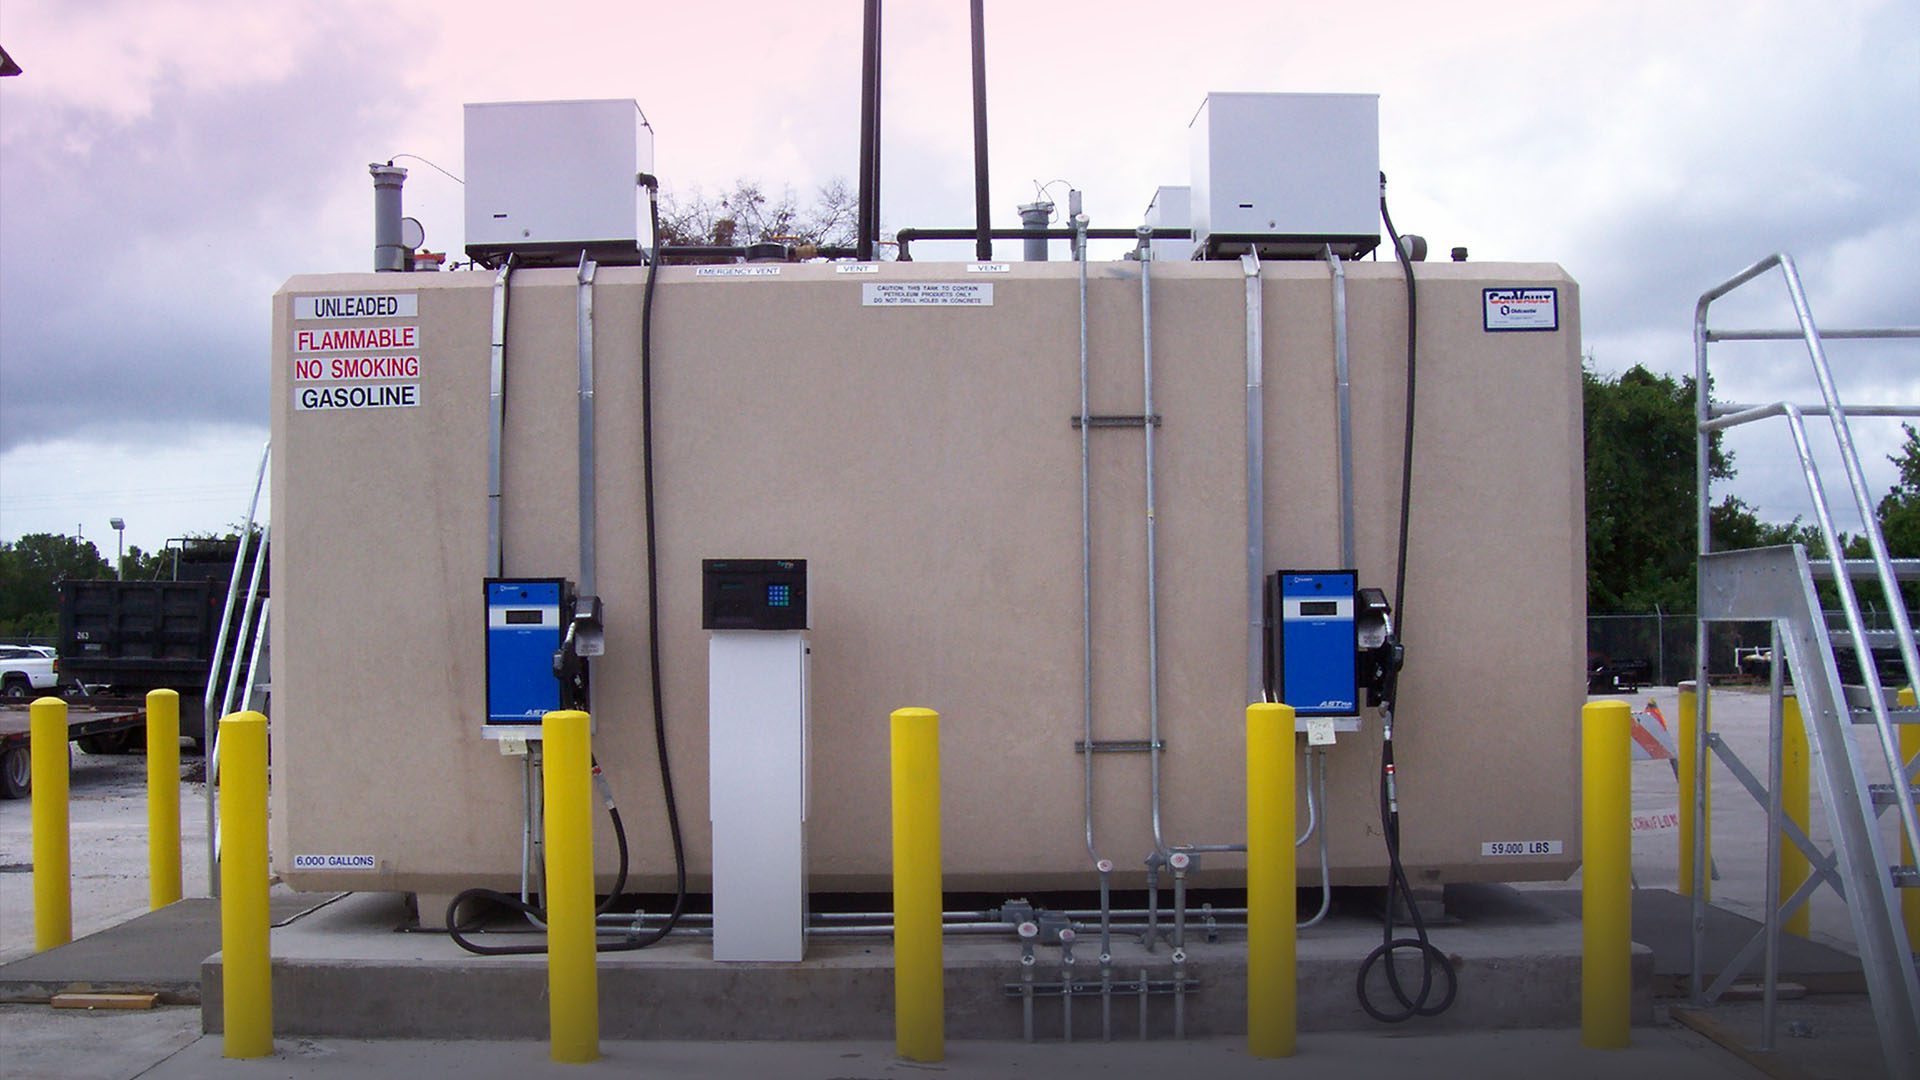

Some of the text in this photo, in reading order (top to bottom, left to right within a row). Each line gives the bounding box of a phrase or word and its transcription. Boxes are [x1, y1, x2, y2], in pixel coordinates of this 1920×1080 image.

[315, 296, 398, 318] UNLEADED
[298, 327, 415, 351] FLAMMABLE
[296, 356, 418, 379] NO SMOKING
[302, 386, 415, 408] GASOLINE
[1529, 842, 1549, 853] LBS
[296, 856, 374, 866] 6,000 GALLONS
